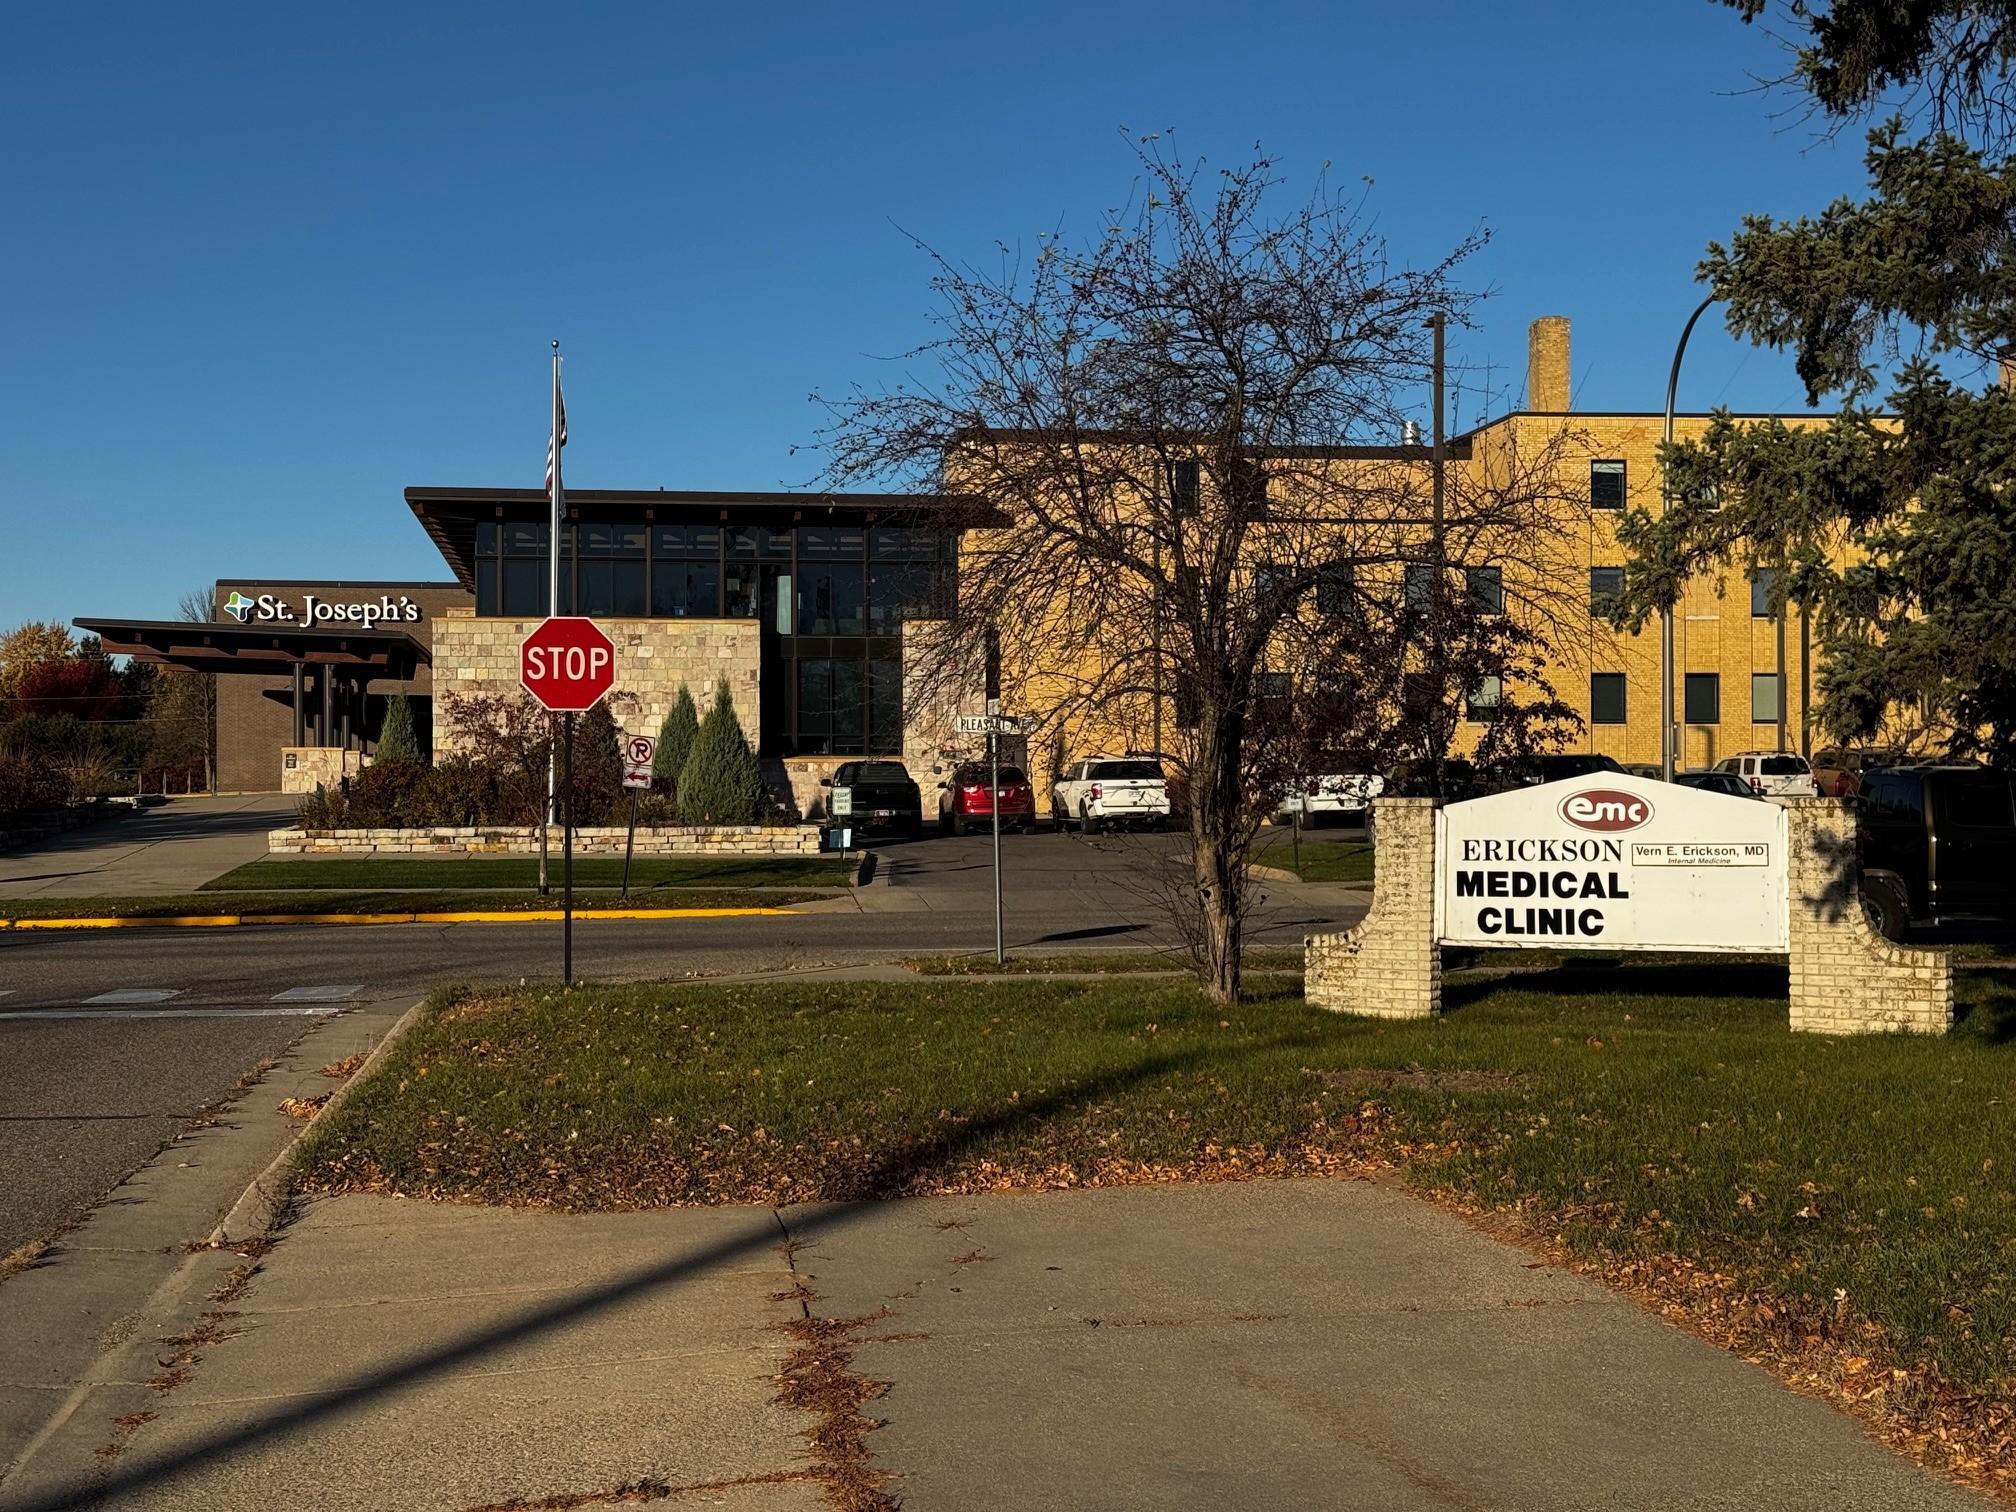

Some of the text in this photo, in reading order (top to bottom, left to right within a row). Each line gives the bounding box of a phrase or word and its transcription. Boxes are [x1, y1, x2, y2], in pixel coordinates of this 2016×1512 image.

[257, 595, 418, 629] St. Joseph's
[526, 646, 609, 681] STOP
[1567, 797, 1641, 822] emc
[1462, 839, 1624, 862] ERICKSON
[1636, 846, 1765, 858] Vern E. Erickson, MD
[1456, 871, 1630, 899] MEDICAL
[1477, 907, 1604, 936] CLINIC
